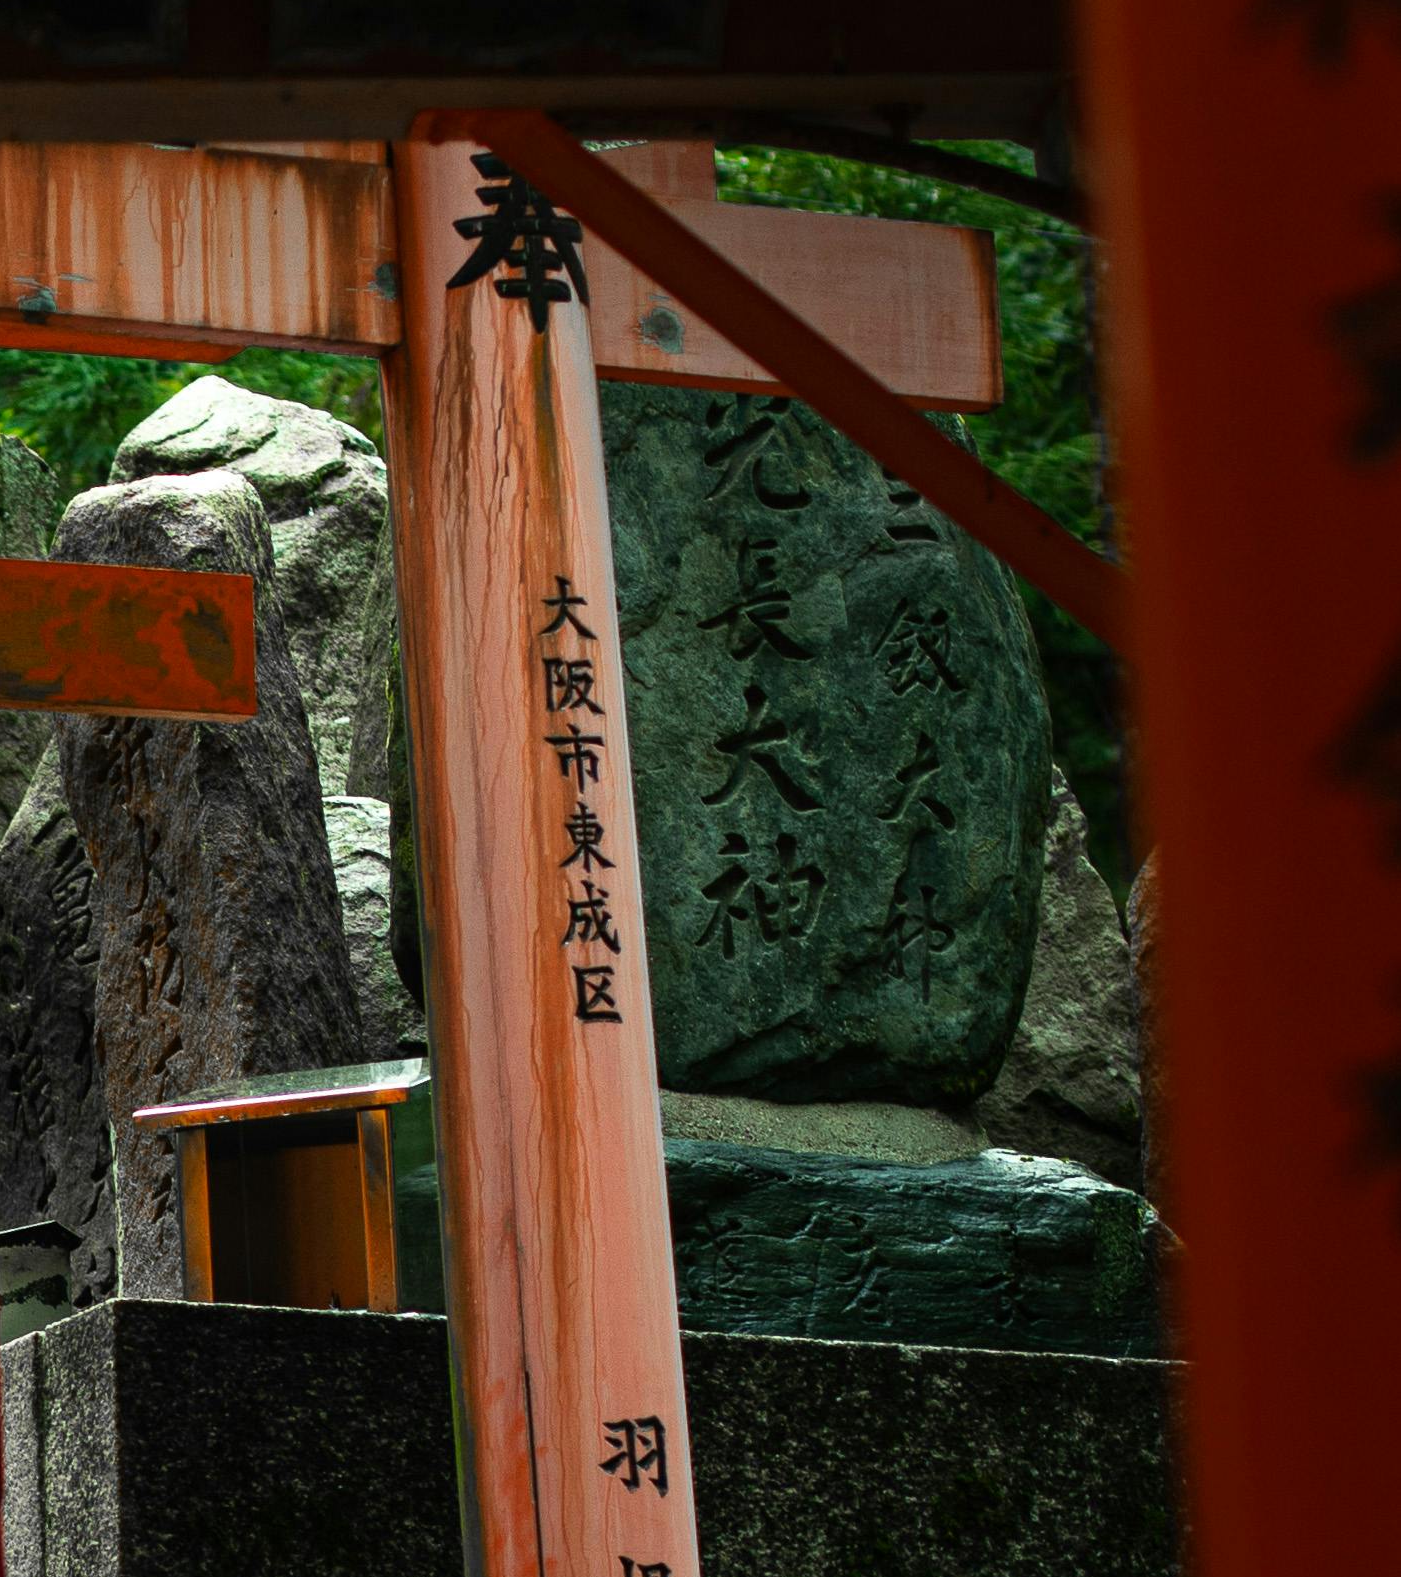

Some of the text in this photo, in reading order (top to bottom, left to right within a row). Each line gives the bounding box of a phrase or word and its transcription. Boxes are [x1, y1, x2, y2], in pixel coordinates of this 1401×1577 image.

[446, 152, 588, 334] 奉
[539, 575, 624, 1024] 大阪市東成区
